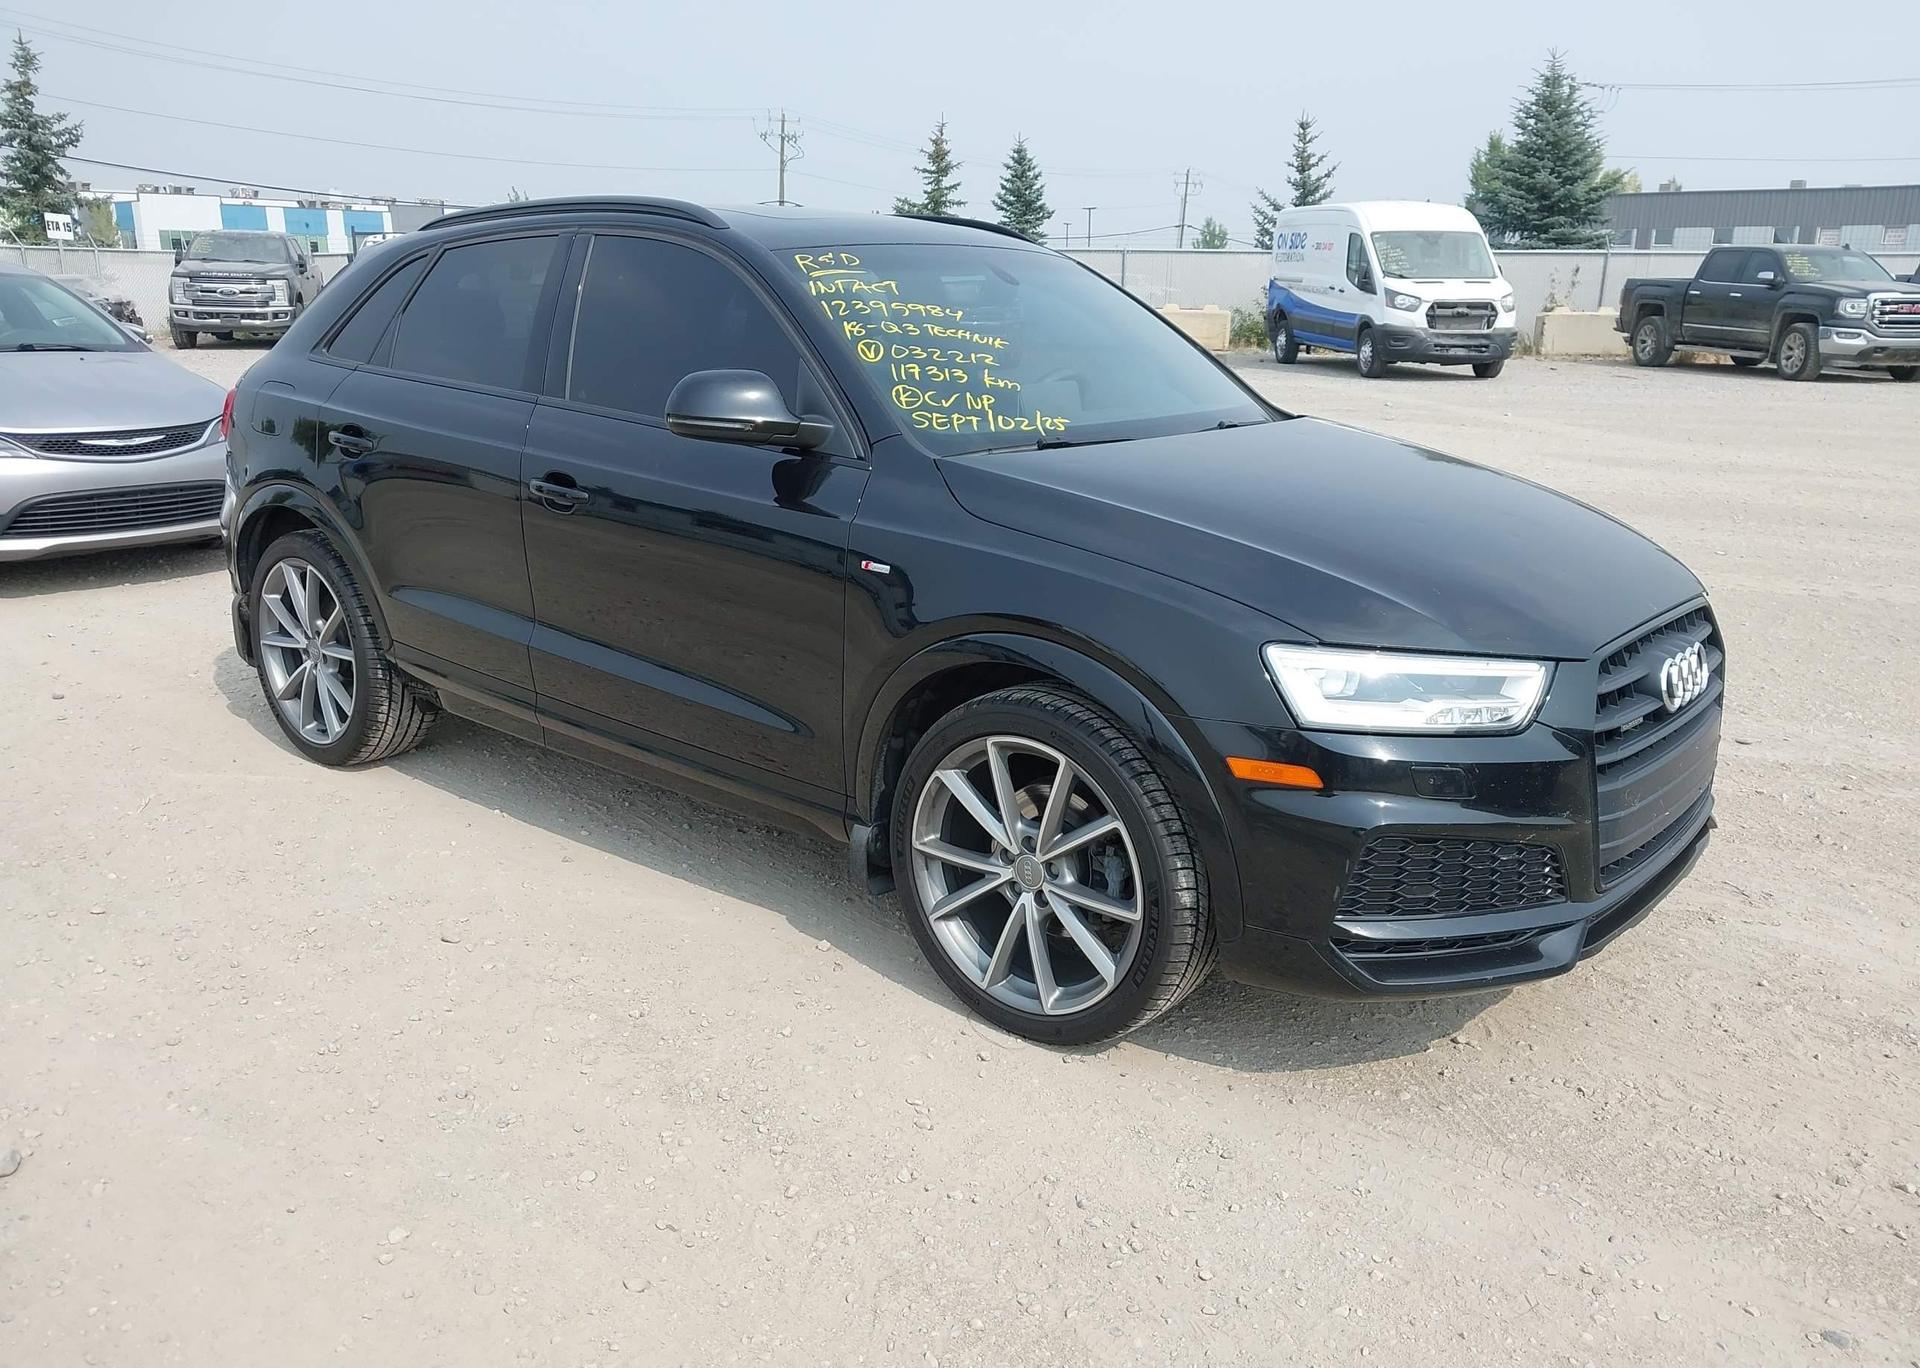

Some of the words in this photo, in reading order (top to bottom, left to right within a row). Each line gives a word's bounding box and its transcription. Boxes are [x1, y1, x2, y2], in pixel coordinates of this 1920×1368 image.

[46, 220, 60, 231] ETA
[62, 222, 72, 232] 15
[809, 279, 899, 296] INTACT
[821, 300, 964, 320] 12395984
[891, 345, 1000, 366] 032212
